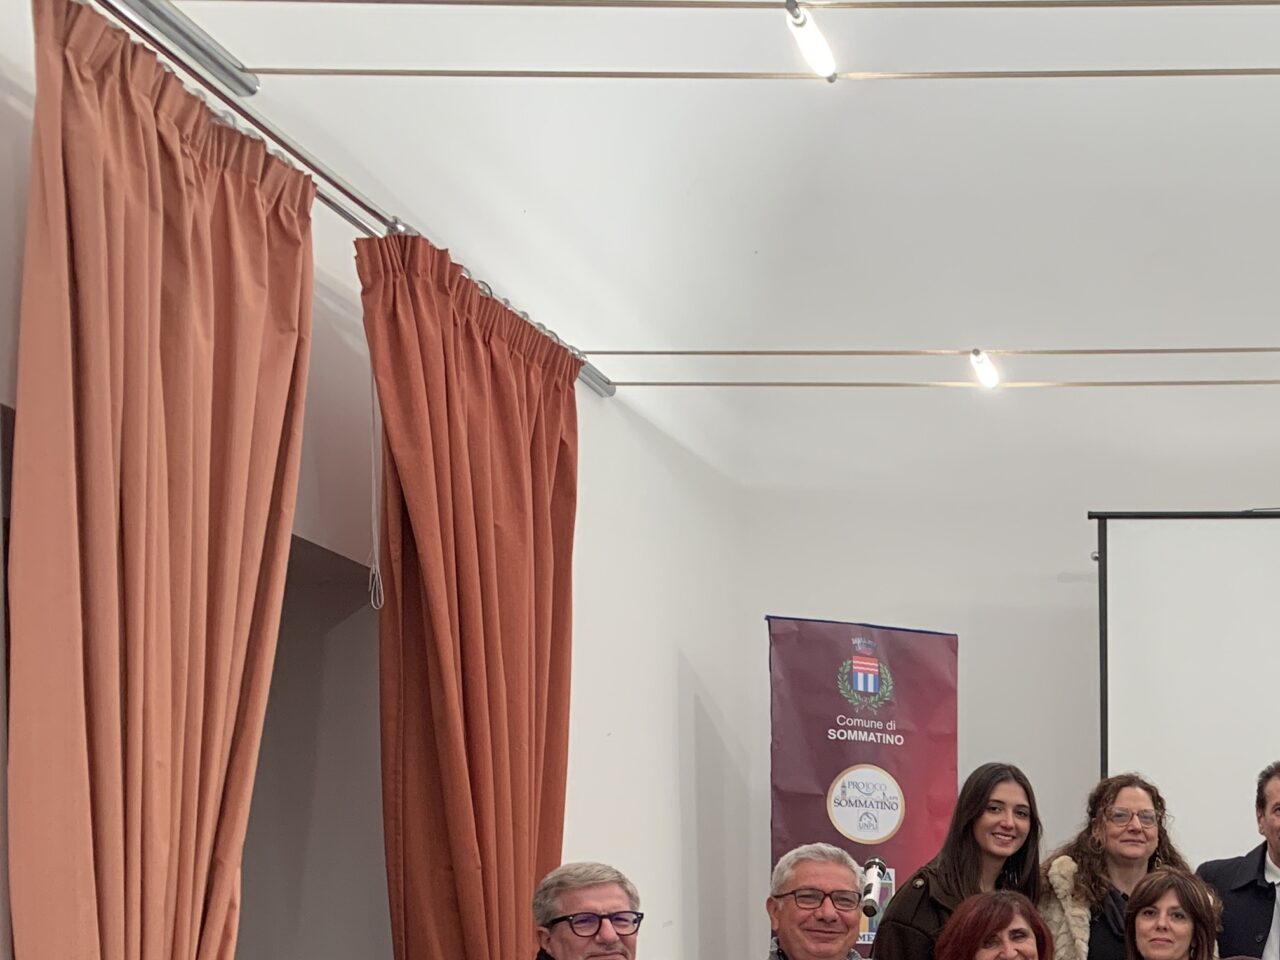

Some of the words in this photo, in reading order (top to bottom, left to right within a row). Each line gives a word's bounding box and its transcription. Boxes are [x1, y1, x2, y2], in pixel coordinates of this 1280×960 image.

[836, 715, 883, 730] Comune
[886, 720, 896, 731] di
[827, 729, 904, 746] SOMMATINO
[833, 798, 899, 812] SOMMATINO
